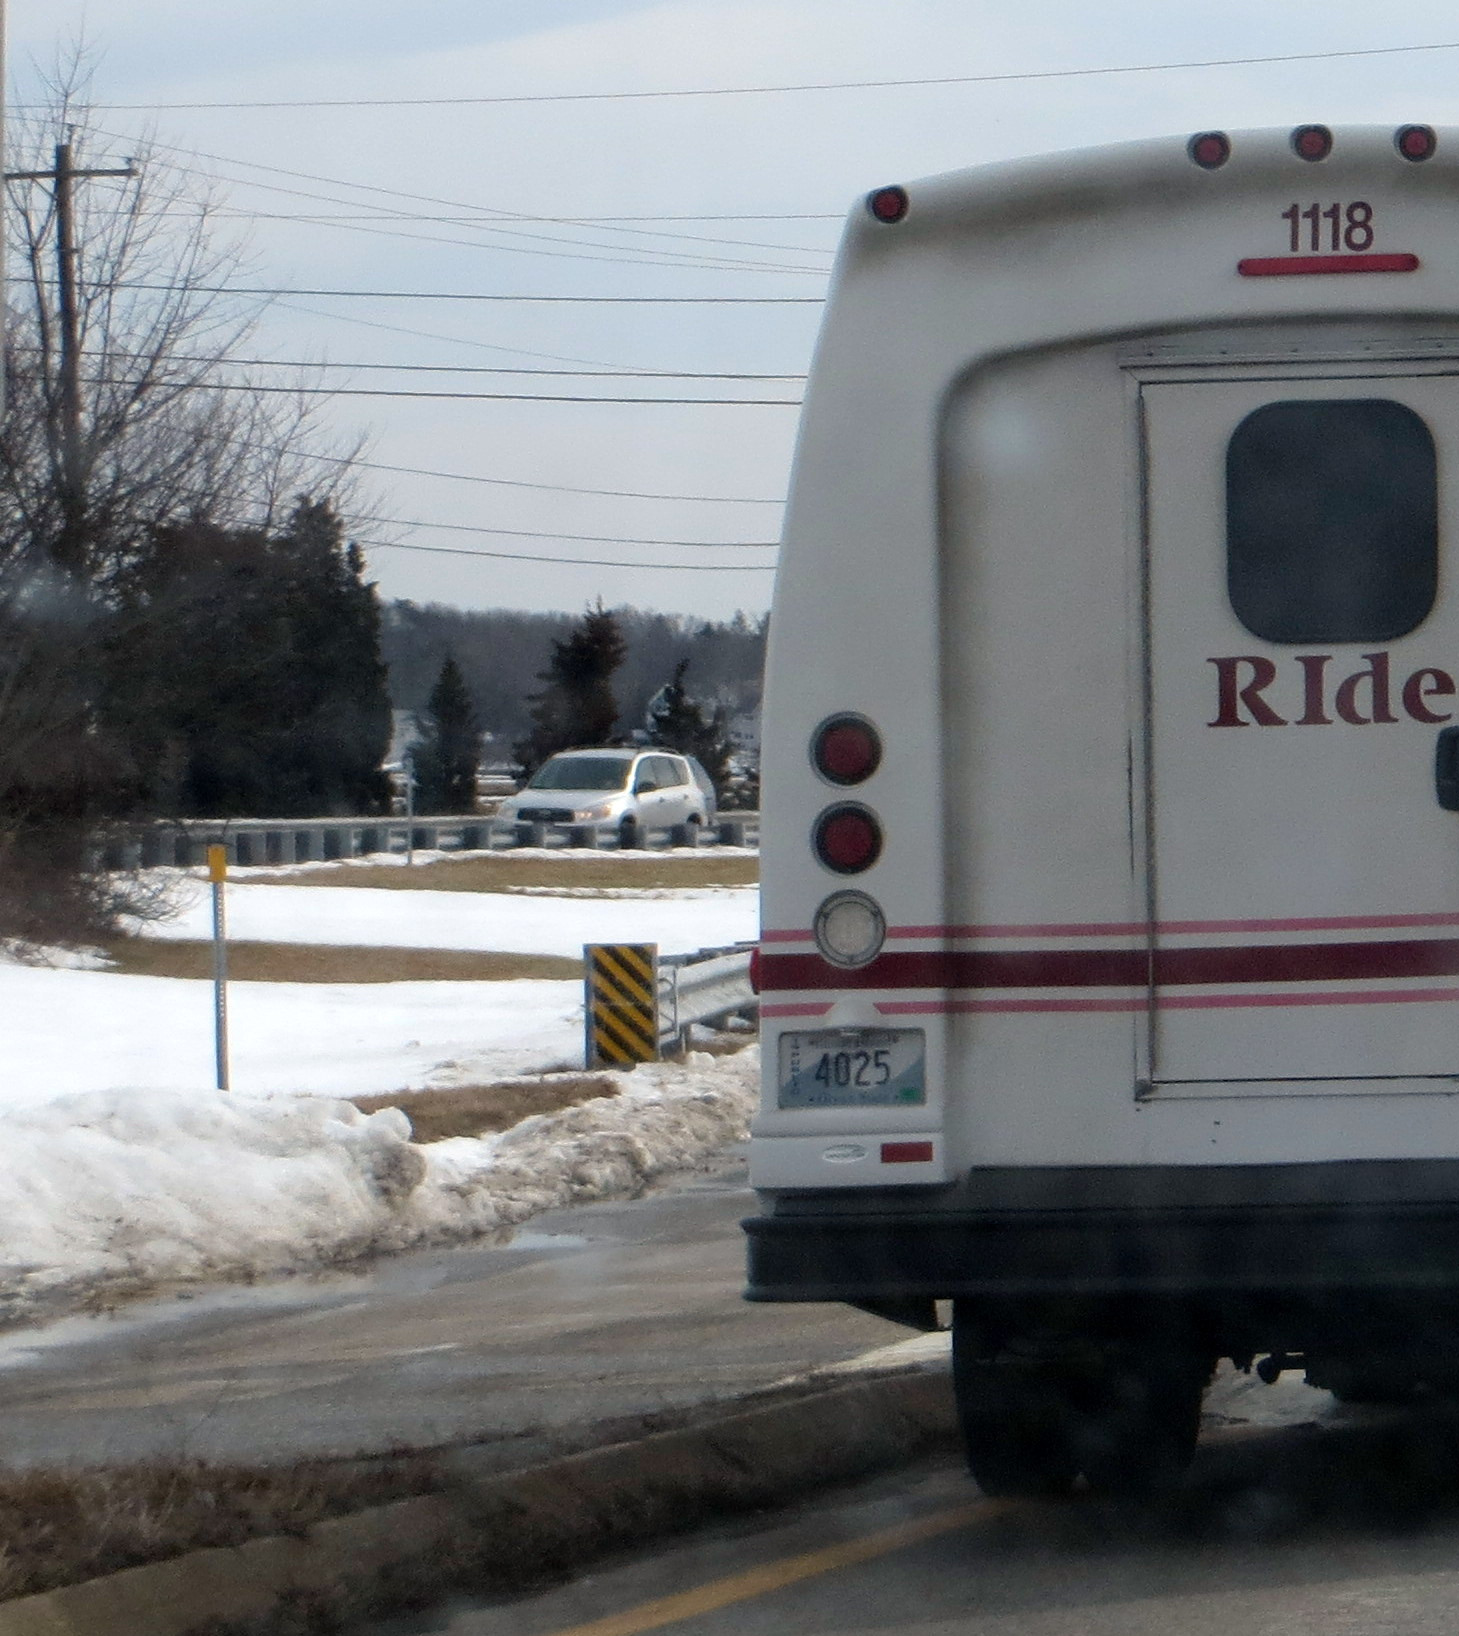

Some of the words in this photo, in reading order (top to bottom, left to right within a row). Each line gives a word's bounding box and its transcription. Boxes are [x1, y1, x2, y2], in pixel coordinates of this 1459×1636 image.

[1281, 201, 1374, 252] 1118
[1206, 651, 1457, 728] RIde
[814, 1049, 891, 1088] 4025
